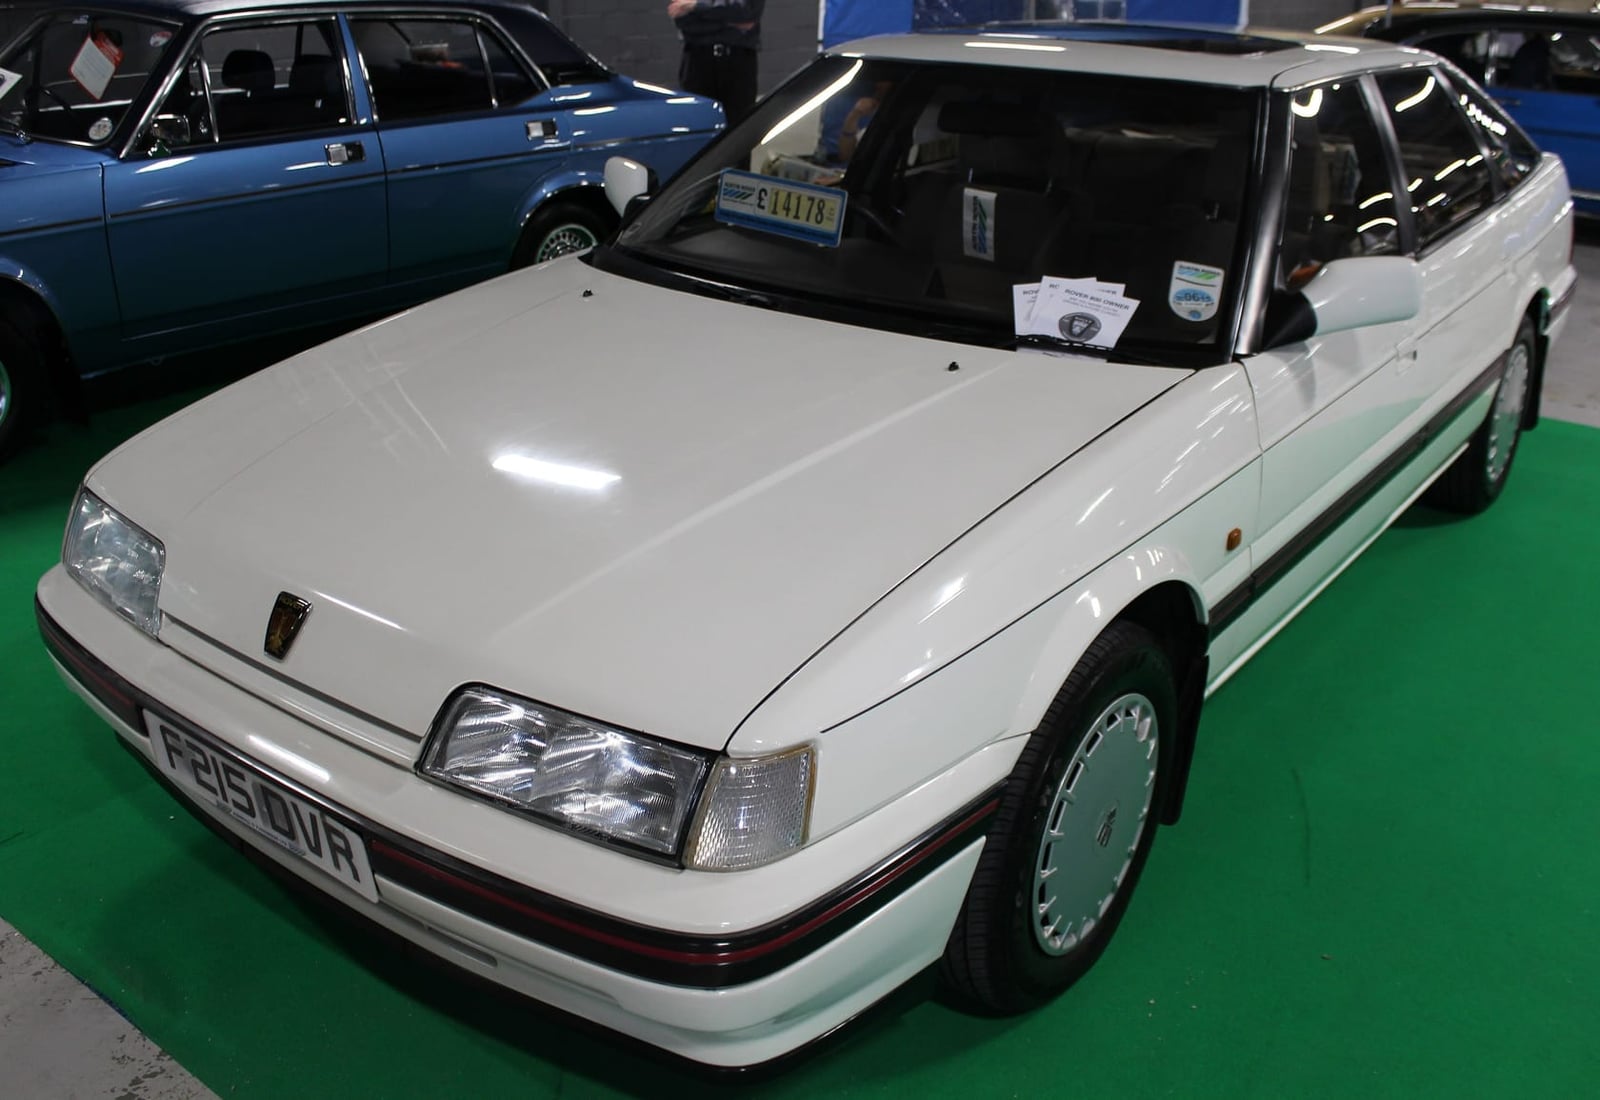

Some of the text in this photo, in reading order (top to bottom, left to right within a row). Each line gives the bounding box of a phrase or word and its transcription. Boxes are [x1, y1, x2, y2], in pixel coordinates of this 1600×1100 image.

[1065, 289, 1088, 299] ROVER
[1103, 299, 1130, 311] OWNER
[160, 725, 255, 818] F215
[260, 784, 360, 883] DVR
